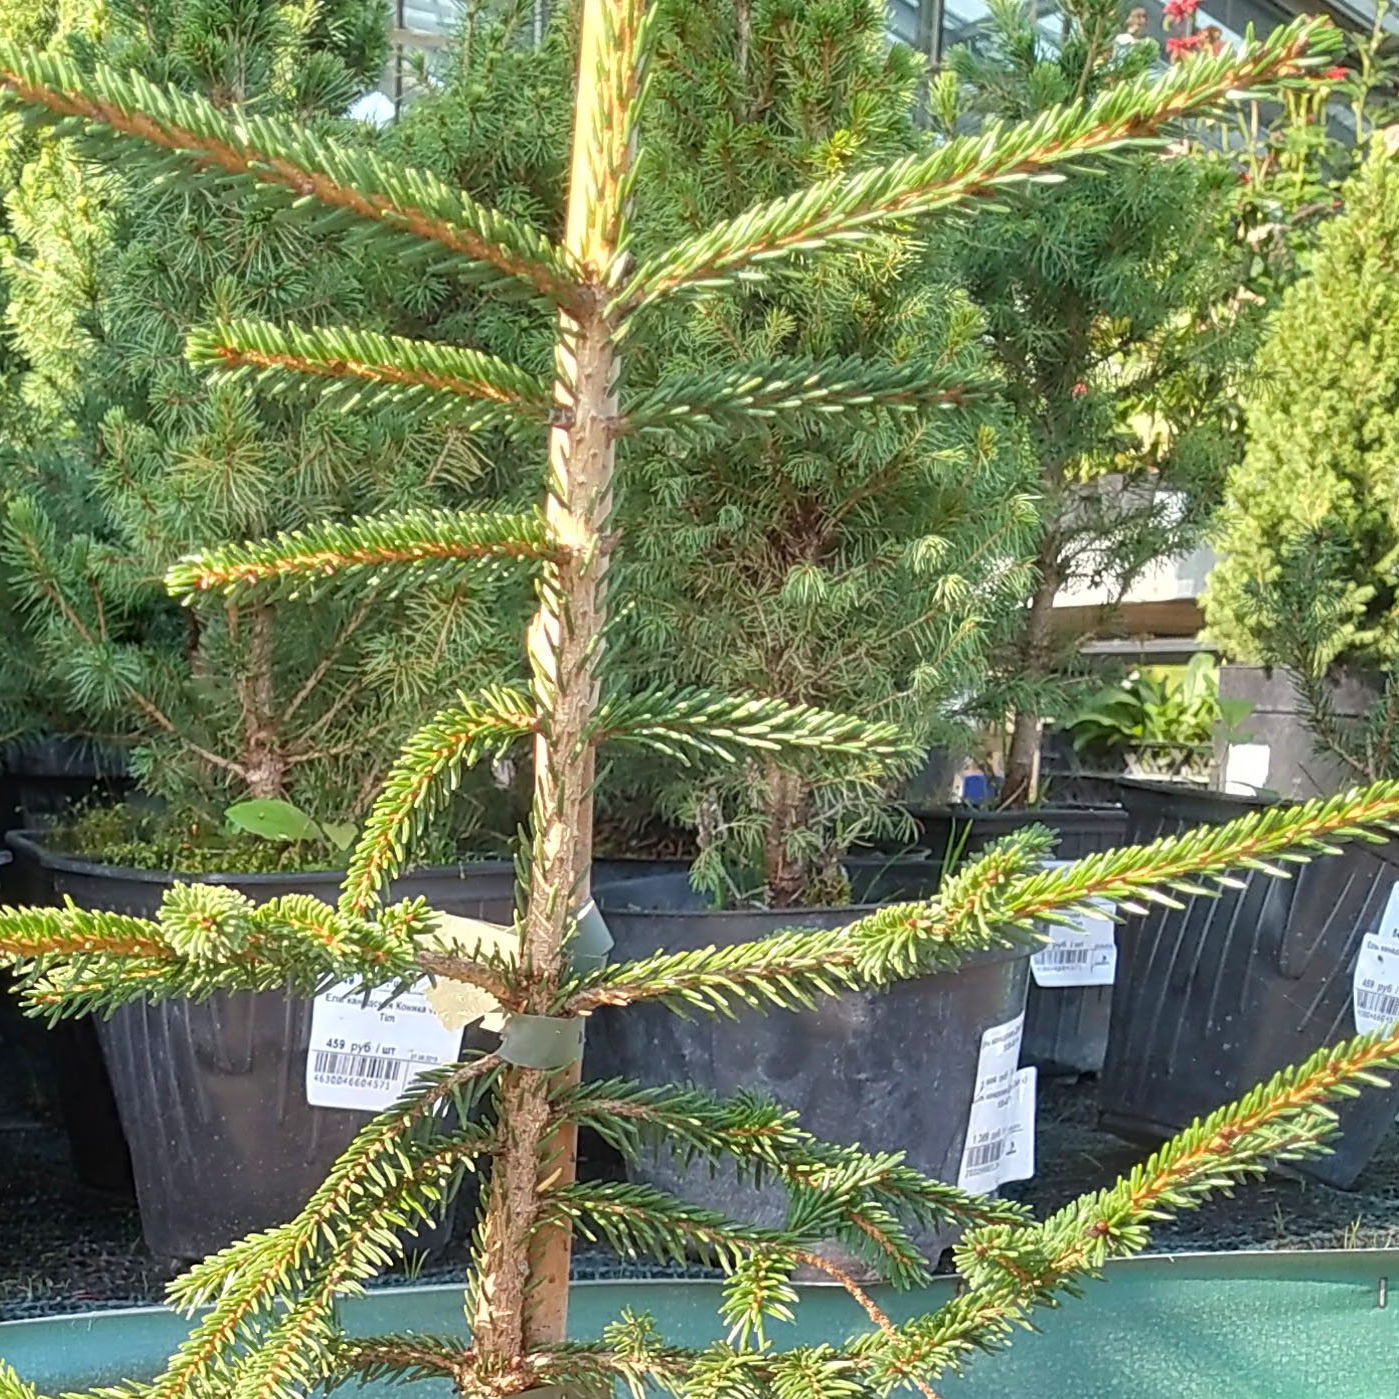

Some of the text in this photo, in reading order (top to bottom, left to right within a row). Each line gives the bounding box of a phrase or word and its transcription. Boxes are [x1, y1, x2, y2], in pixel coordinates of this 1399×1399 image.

[379, 1013, 395, 1022] Tim
[326, 1038, 345, 1049] 459
[351, 1041, 371, 1054] руб
[382, 1046, 396, 1055] шт
